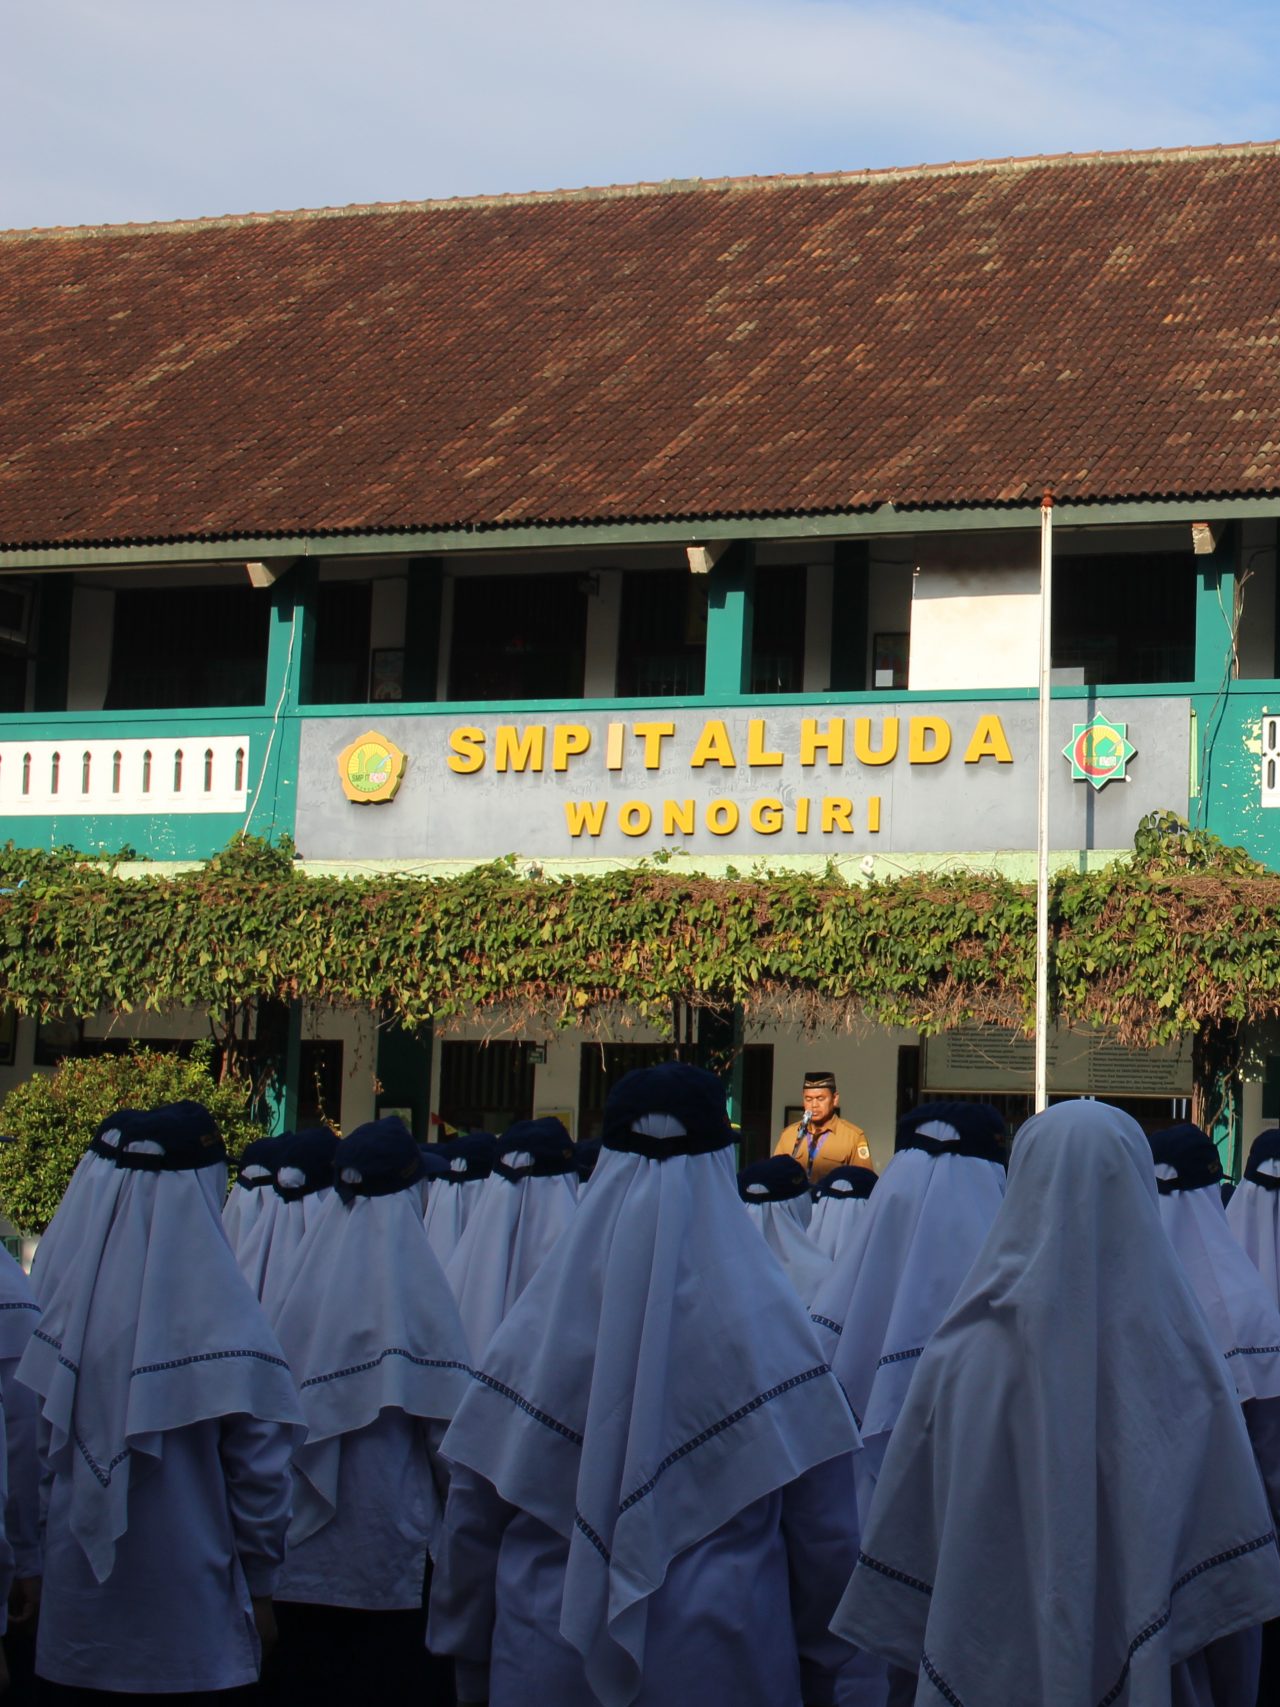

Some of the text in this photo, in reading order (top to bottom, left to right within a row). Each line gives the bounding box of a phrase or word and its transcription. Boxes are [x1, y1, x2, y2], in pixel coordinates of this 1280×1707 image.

[446, 722, 593, 775] SMP
[606, 721, 678, 772] IT
[799, 713, 1015, 768] HUDA
[563, 795, 884, 838] WONOGIRI
